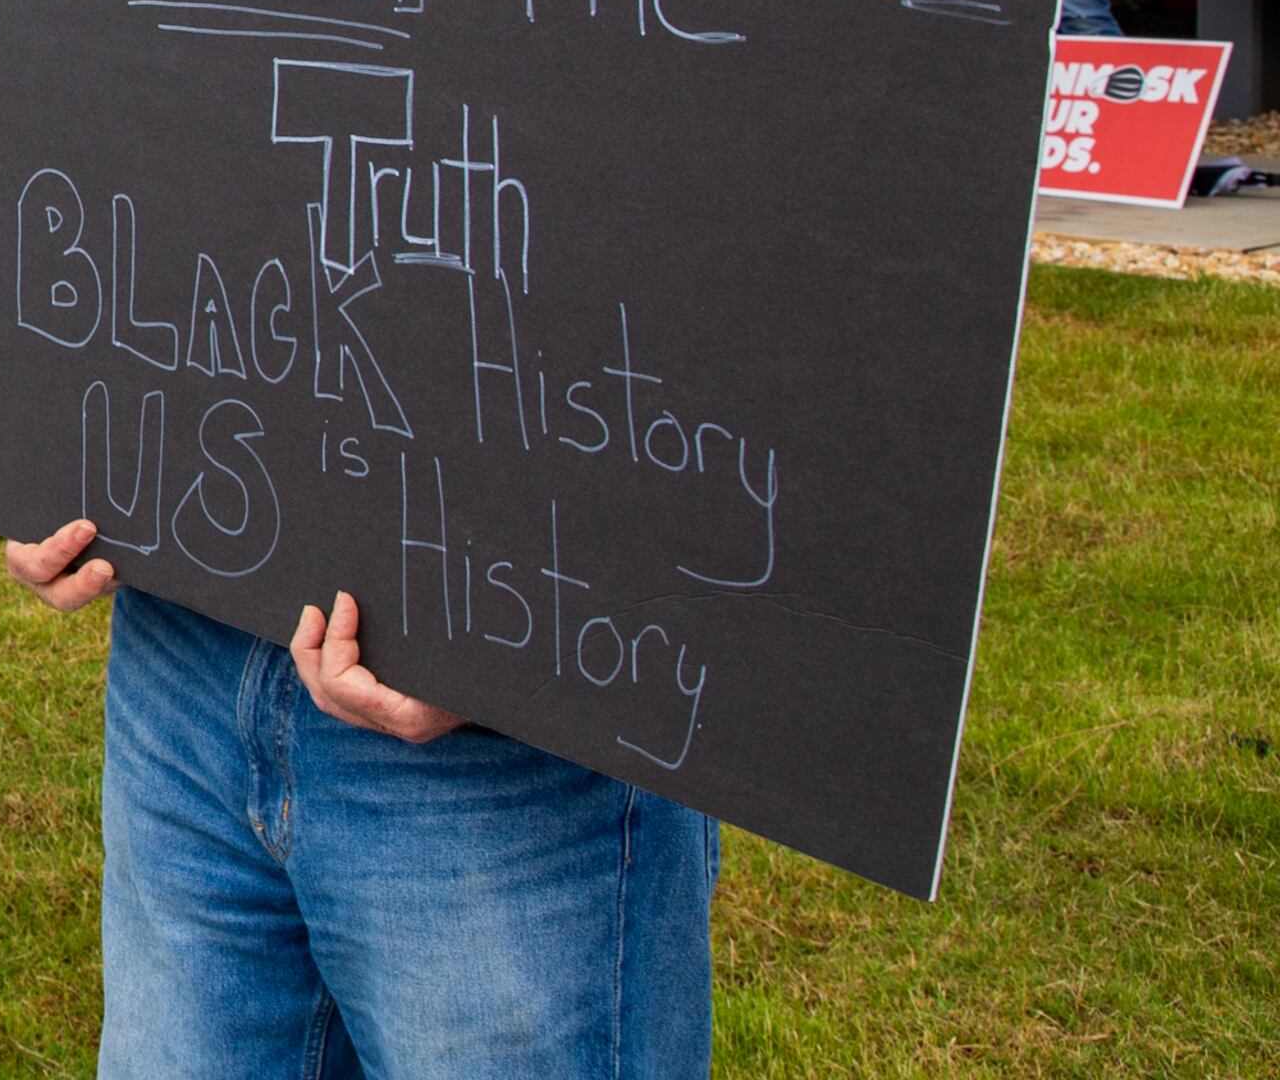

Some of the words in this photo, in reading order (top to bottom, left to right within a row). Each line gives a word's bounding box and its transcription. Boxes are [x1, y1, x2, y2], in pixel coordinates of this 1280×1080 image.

[270, 56, 530, 295] Truth
[1040, 135, 1101, 174] DS.
[1045, 98, 1100, 134] UR
[17, 168, 415, 439] BLACK
[467, 267, 778, 586] History
[82, 380, 281, 577] US
[320, 419, 370, 478] is
